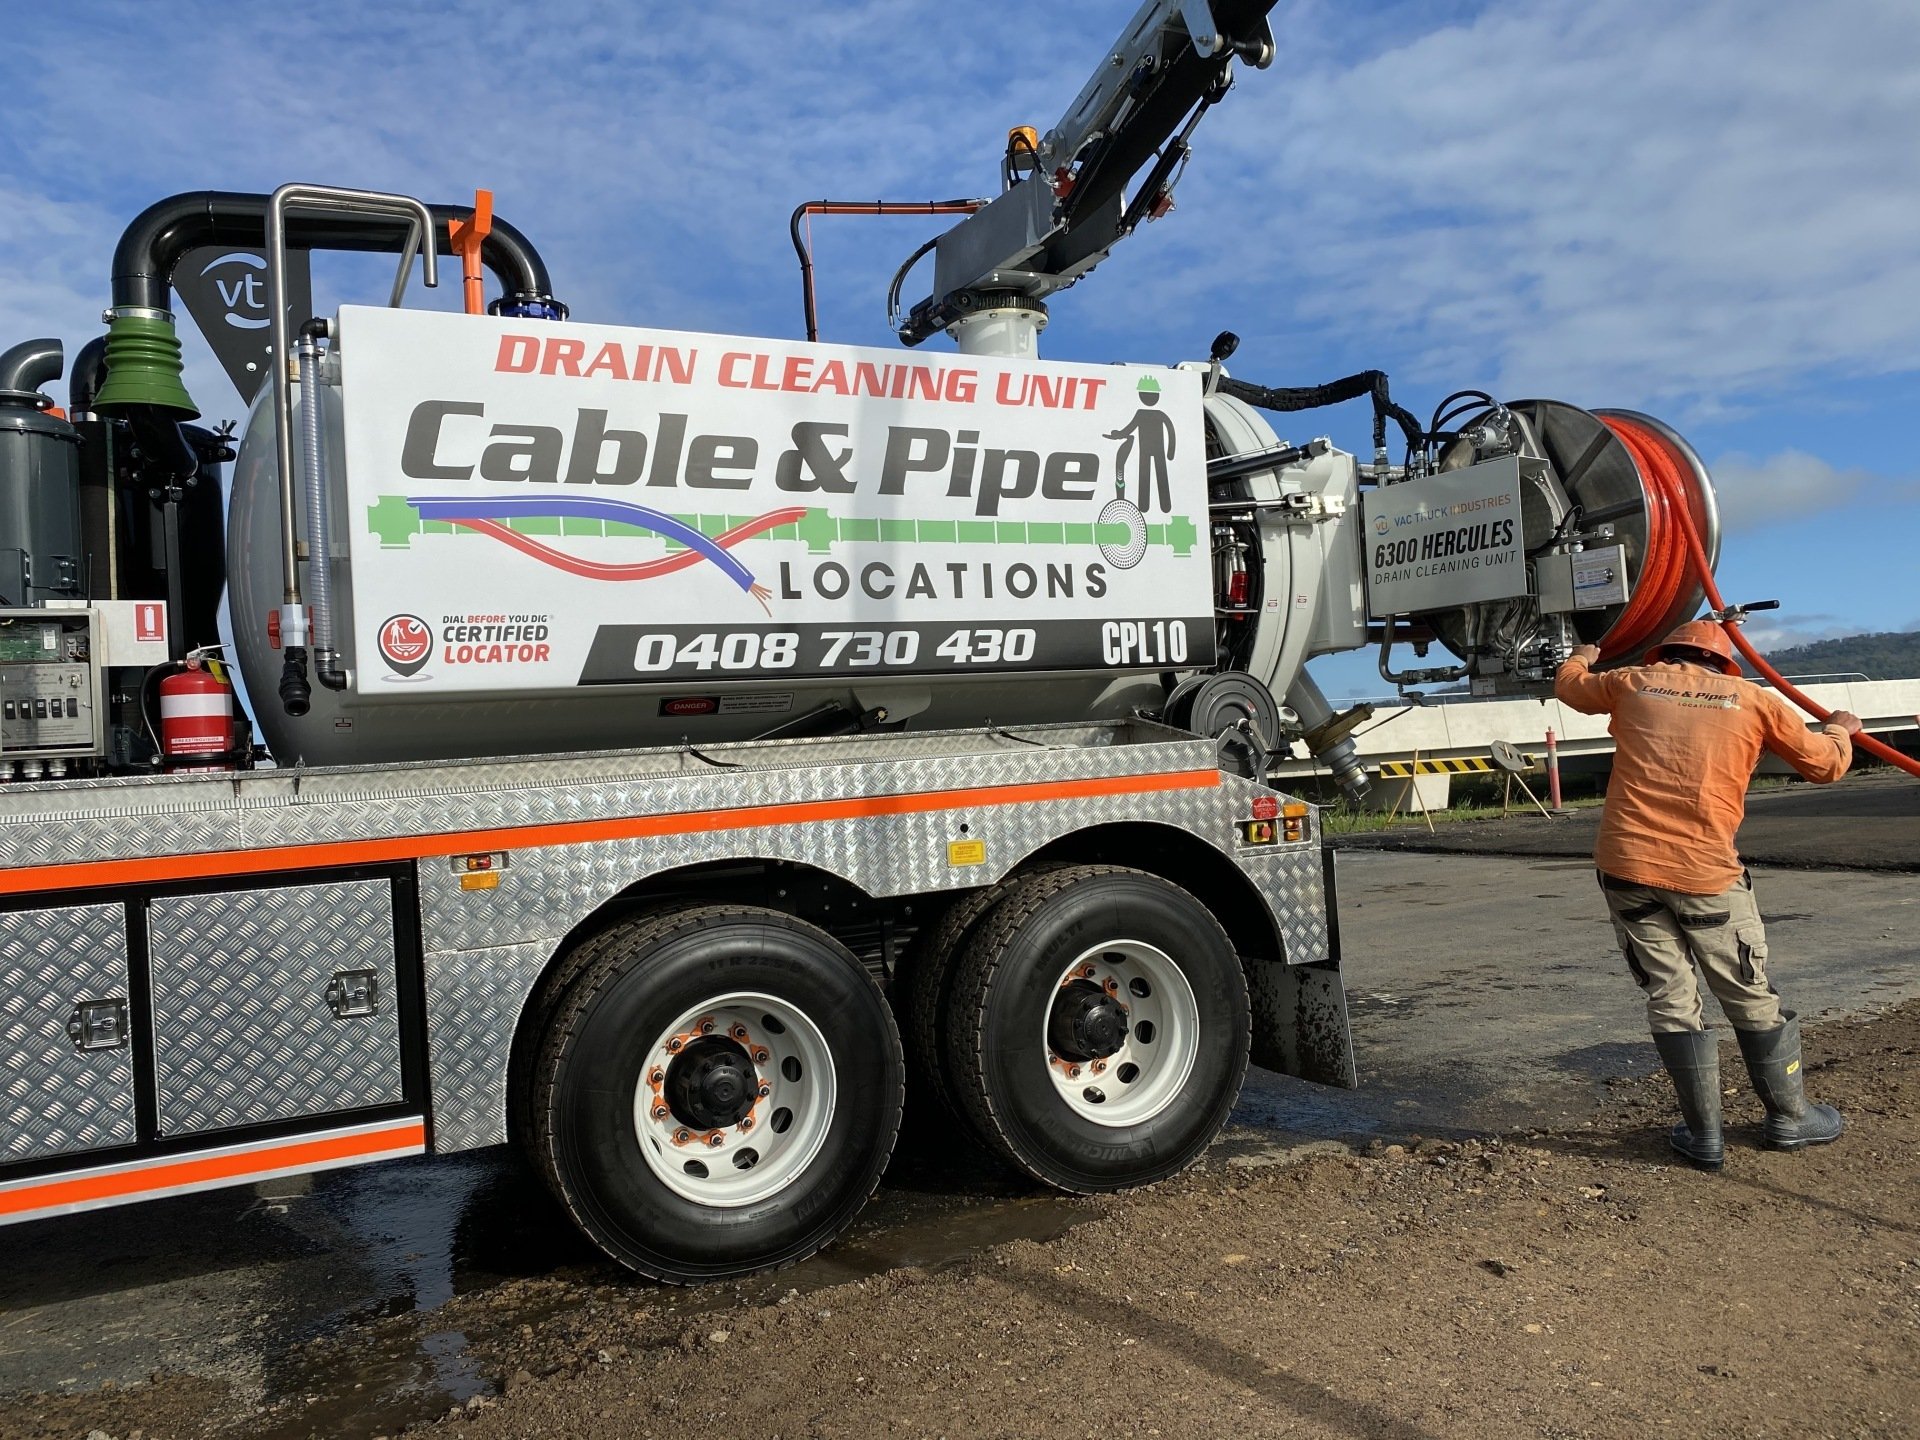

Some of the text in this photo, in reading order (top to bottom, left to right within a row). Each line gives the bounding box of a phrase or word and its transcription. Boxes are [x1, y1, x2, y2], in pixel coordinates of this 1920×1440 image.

[494, 334, 1107, 411] DRAIN CLEANING UNIT
[401, 399, 1101, 517] Cable & Pipe
[1394, 494, 1512, 527] VAC TRUCK INDUSTRIES
[1374, 518, 1514, 569] 6300 HERCULES
[780, 560, 1108, 600] LOCATIONS
[1375, 550, 1517, 585] DRAIN CLEANING UNIT
[442, 614, 548, 624] DIAL BEFORE YOU DIG
[442, 625, 549, 642] CERTIFIED
[444, 643, 551, 664] LOCATOR
[633, 628, 1037, 673] 0408 730 430
[1101, 619, 1188, 666] CPL10
[674, 702, 707, 710] DANGER
[1642, 685, 1729, 702] Cable & Pipe
[1677, 702, 1723, 710] LOCATIONS
